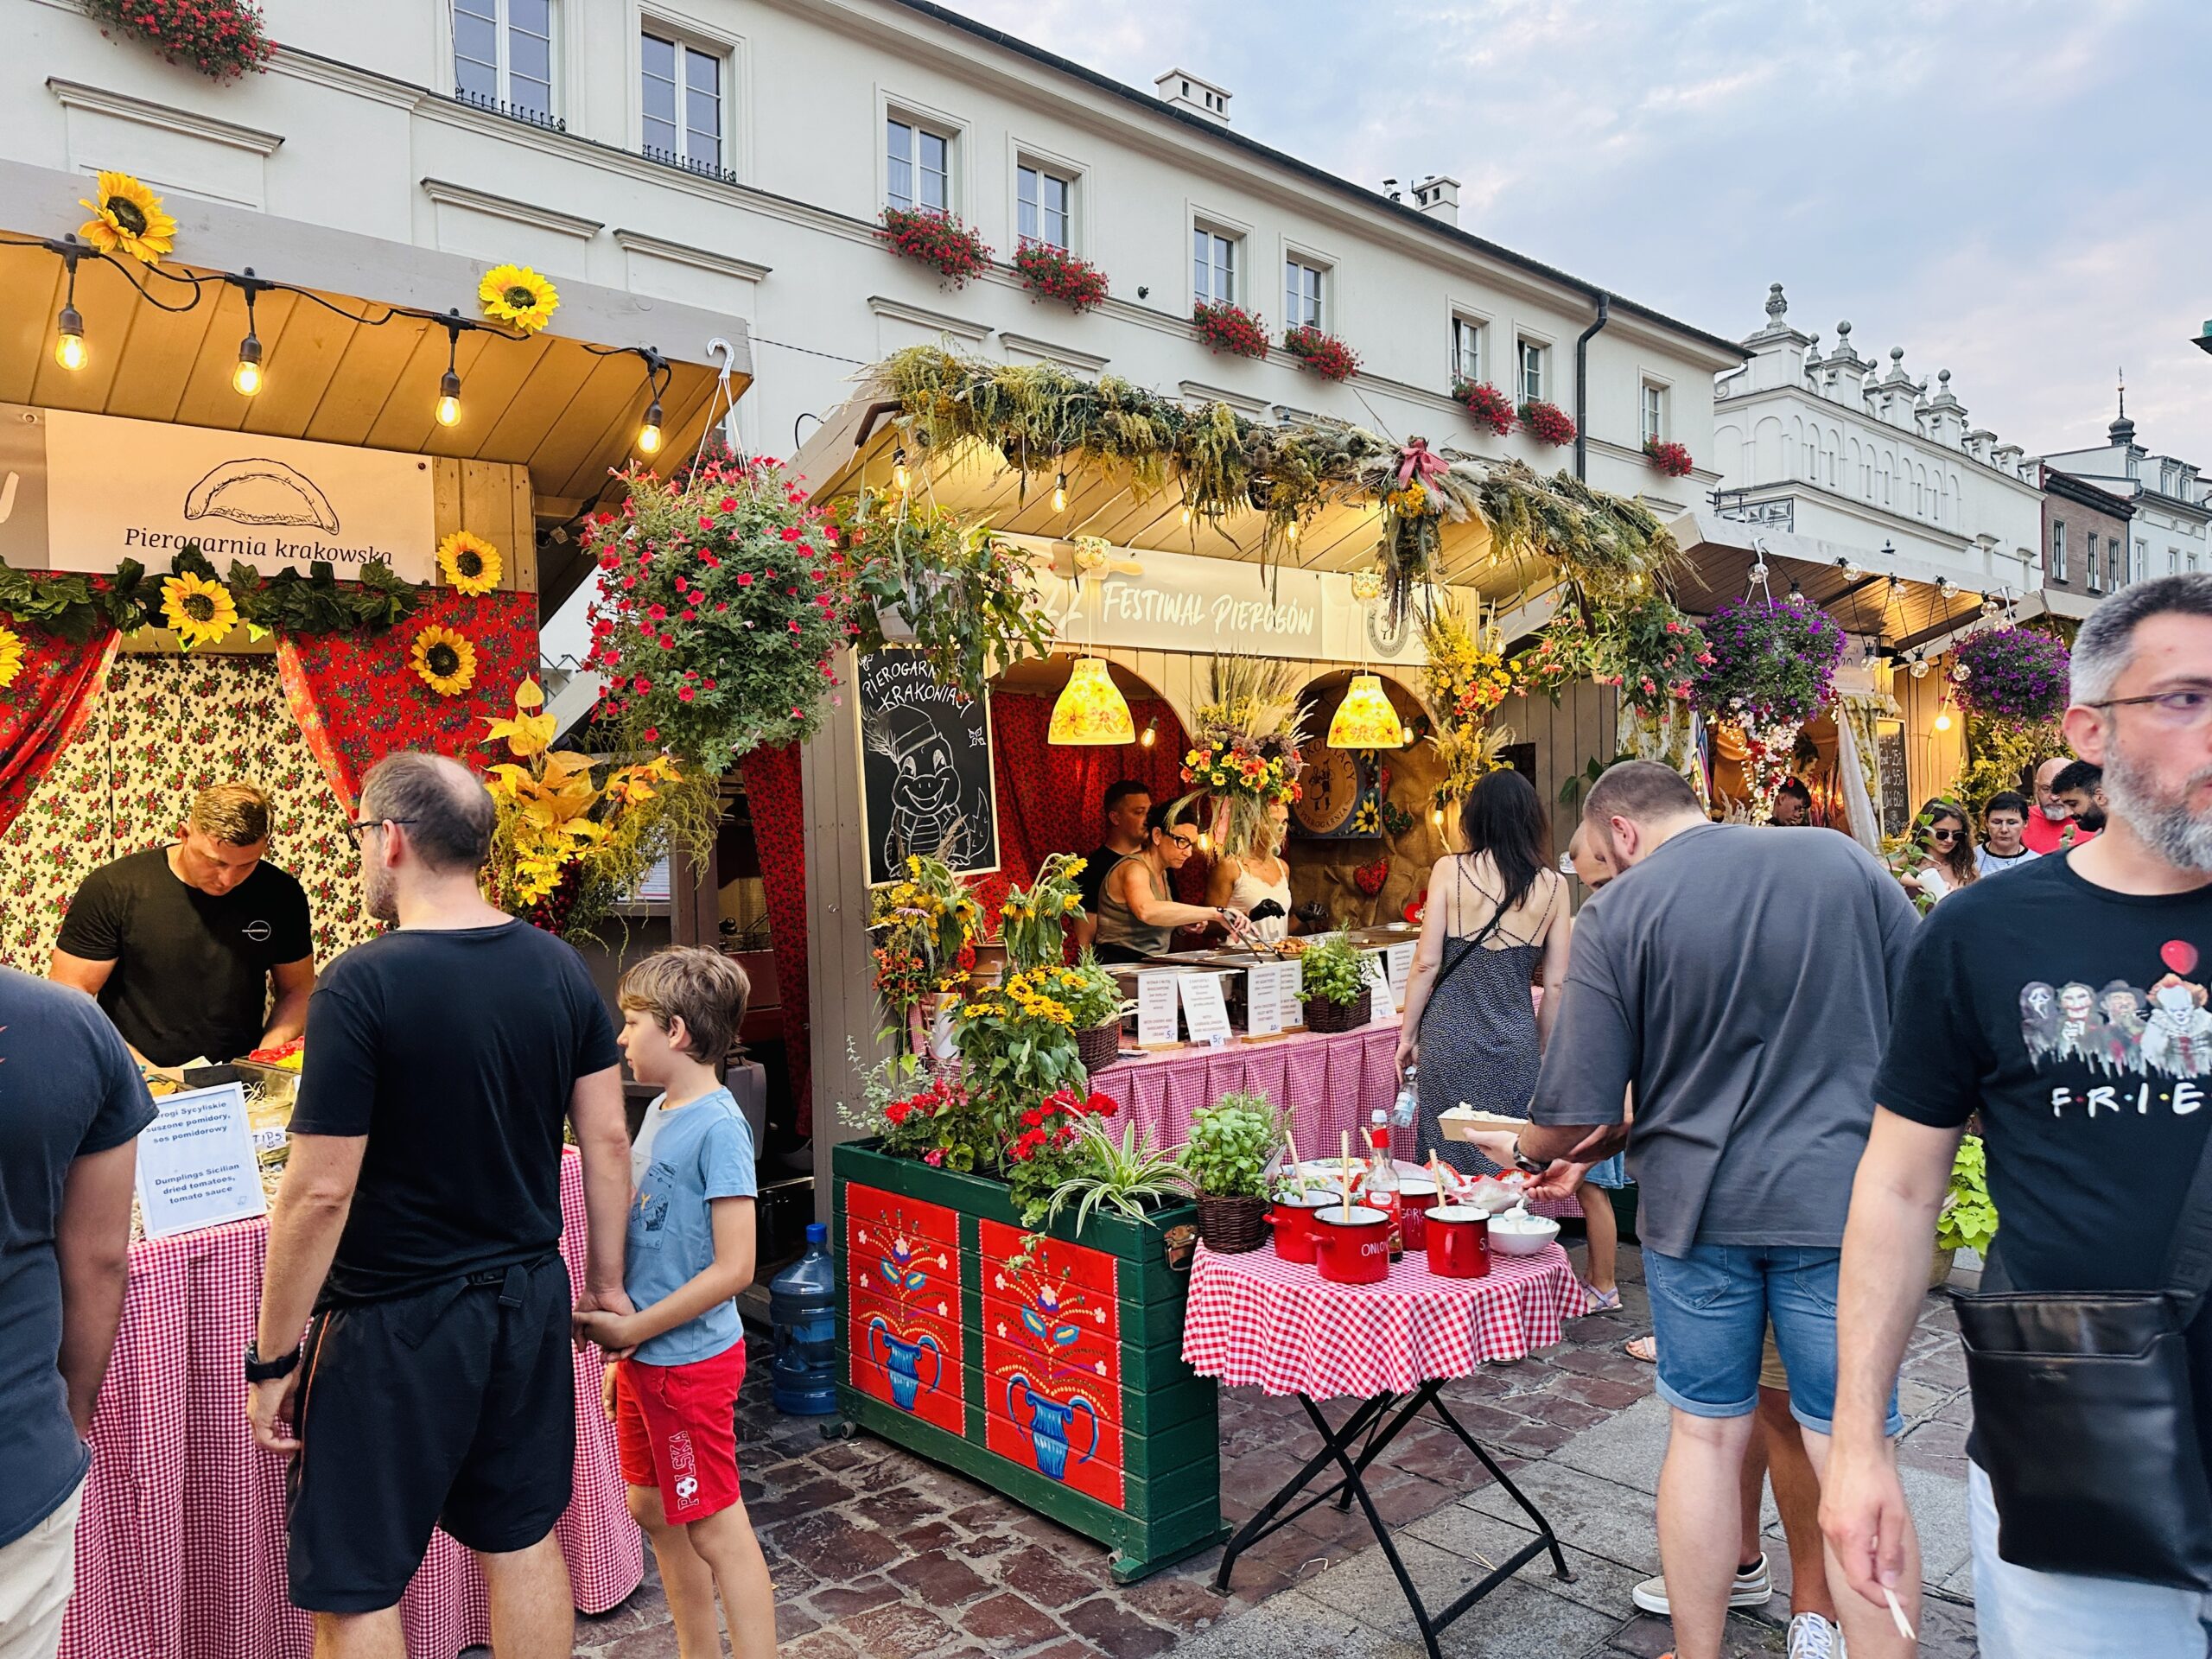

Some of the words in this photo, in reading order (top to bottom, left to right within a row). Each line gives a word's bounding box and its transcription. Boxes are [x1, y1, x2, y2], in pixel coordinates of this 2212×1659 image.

[275, 538, 393, 566] krakowska
[1103, 581, 1206, 627] FESTIWAL
[1211, 594, 1314, 636] PIEROGÓW
[861, 659, 940, 700] PIEROGARN
[156, 1109, 179, 1119] erogi
[181, 1101, 226, 1115] Sycyliskie
[146, 1122, 183, 1133] suszone
[153, 1135, 170, 1144] sos
[172, 1126, 227, 1141] pomidorowy
[155, 1172, 204, 1185] Dumplings
[206, 1163, 240, 1175] Sicilian
[162, 1185, 188, 1195] dried
[189, 1176, 236, 1190] tomatoes,
[169, 1192, 203, 1205] tomato
[205, 1186, 233, 1197] sauce
